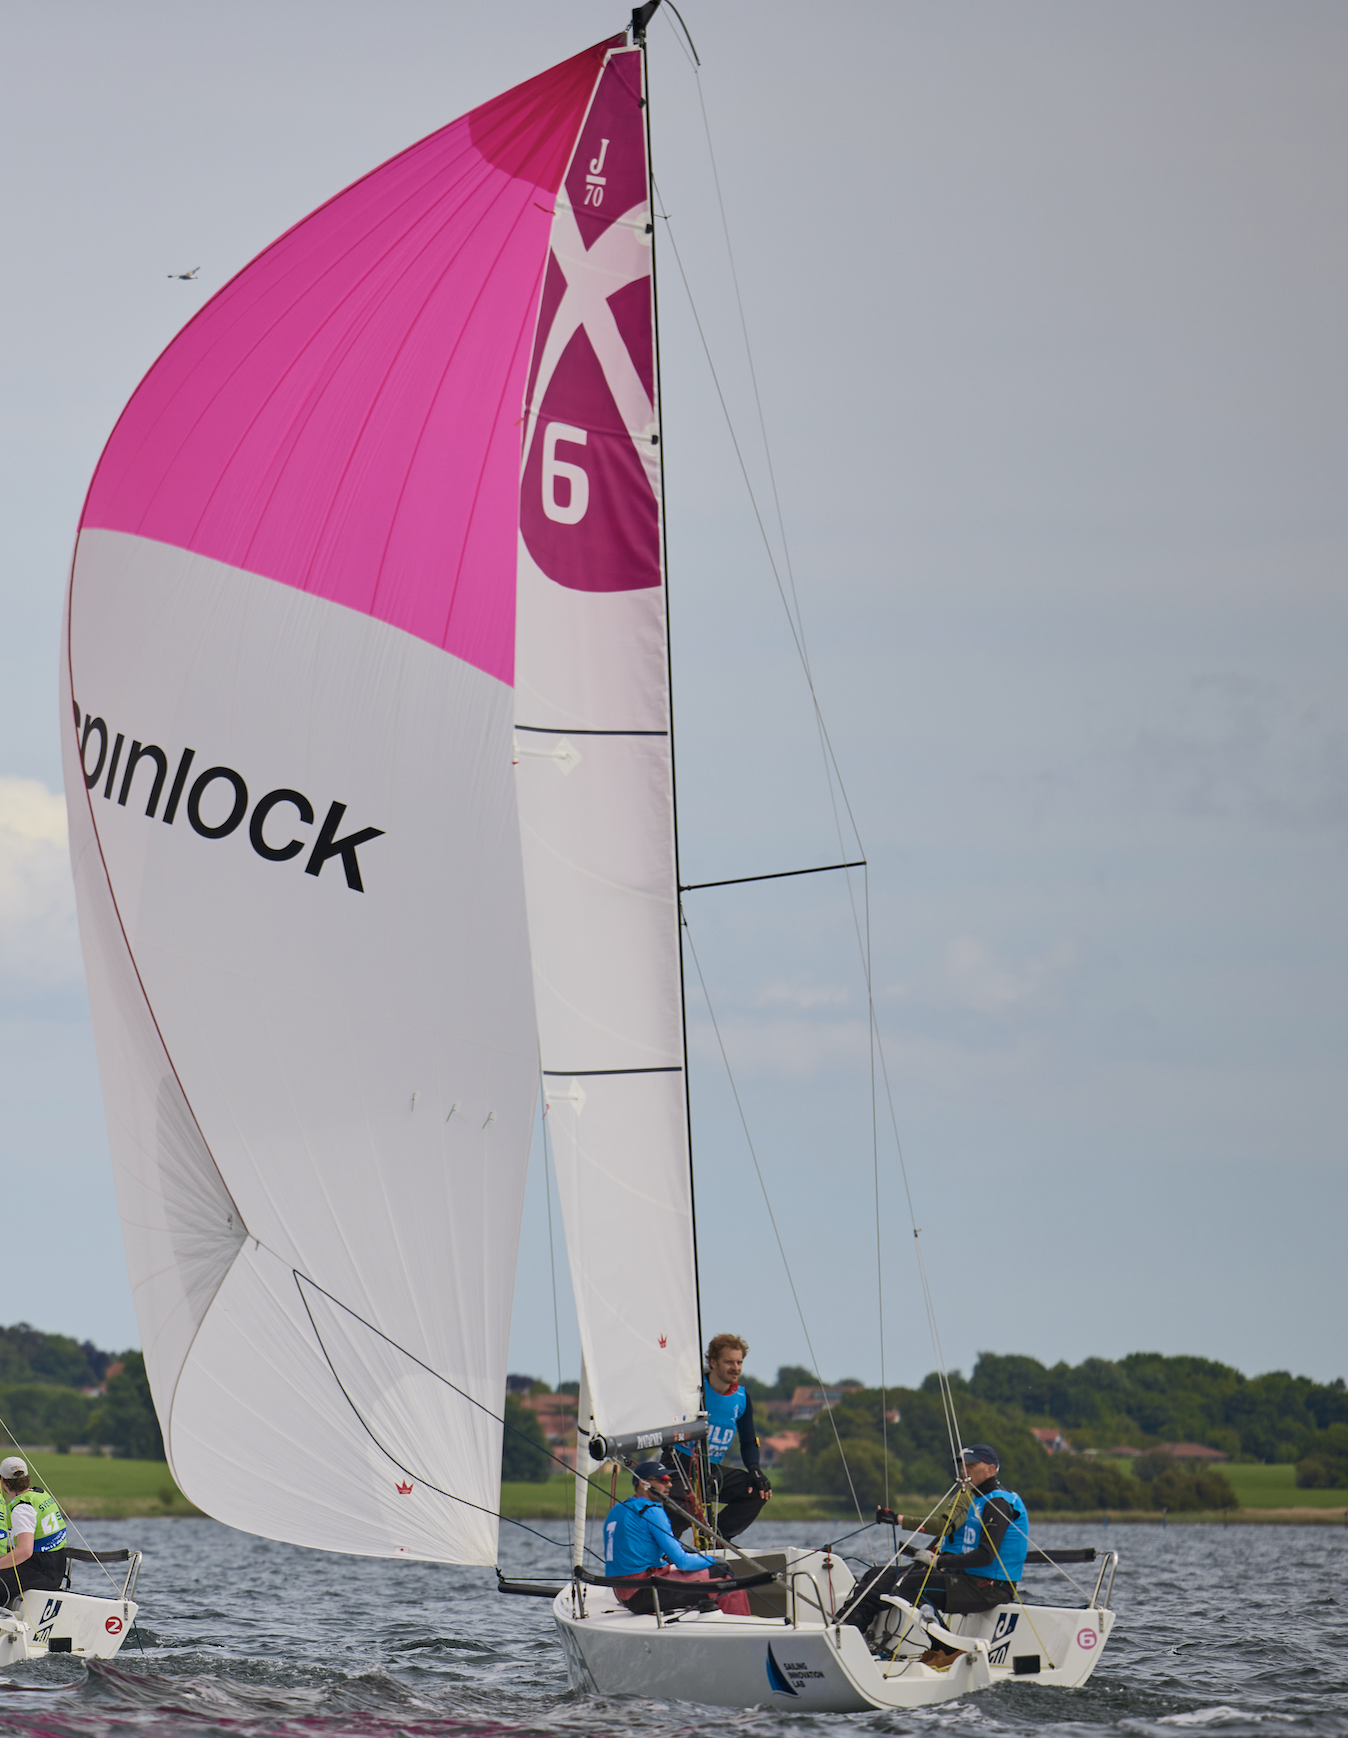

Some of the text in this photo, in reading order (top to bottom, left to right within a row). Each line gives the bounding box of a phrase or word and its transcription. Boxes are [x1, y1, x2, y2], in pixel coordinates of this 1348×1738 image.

[583, 185, 604, 207] 70
[541, 421, 589, 525] 6
[107, 1618, 121, 1632] 2
[1079, 1631, 1095, 1647] 6
